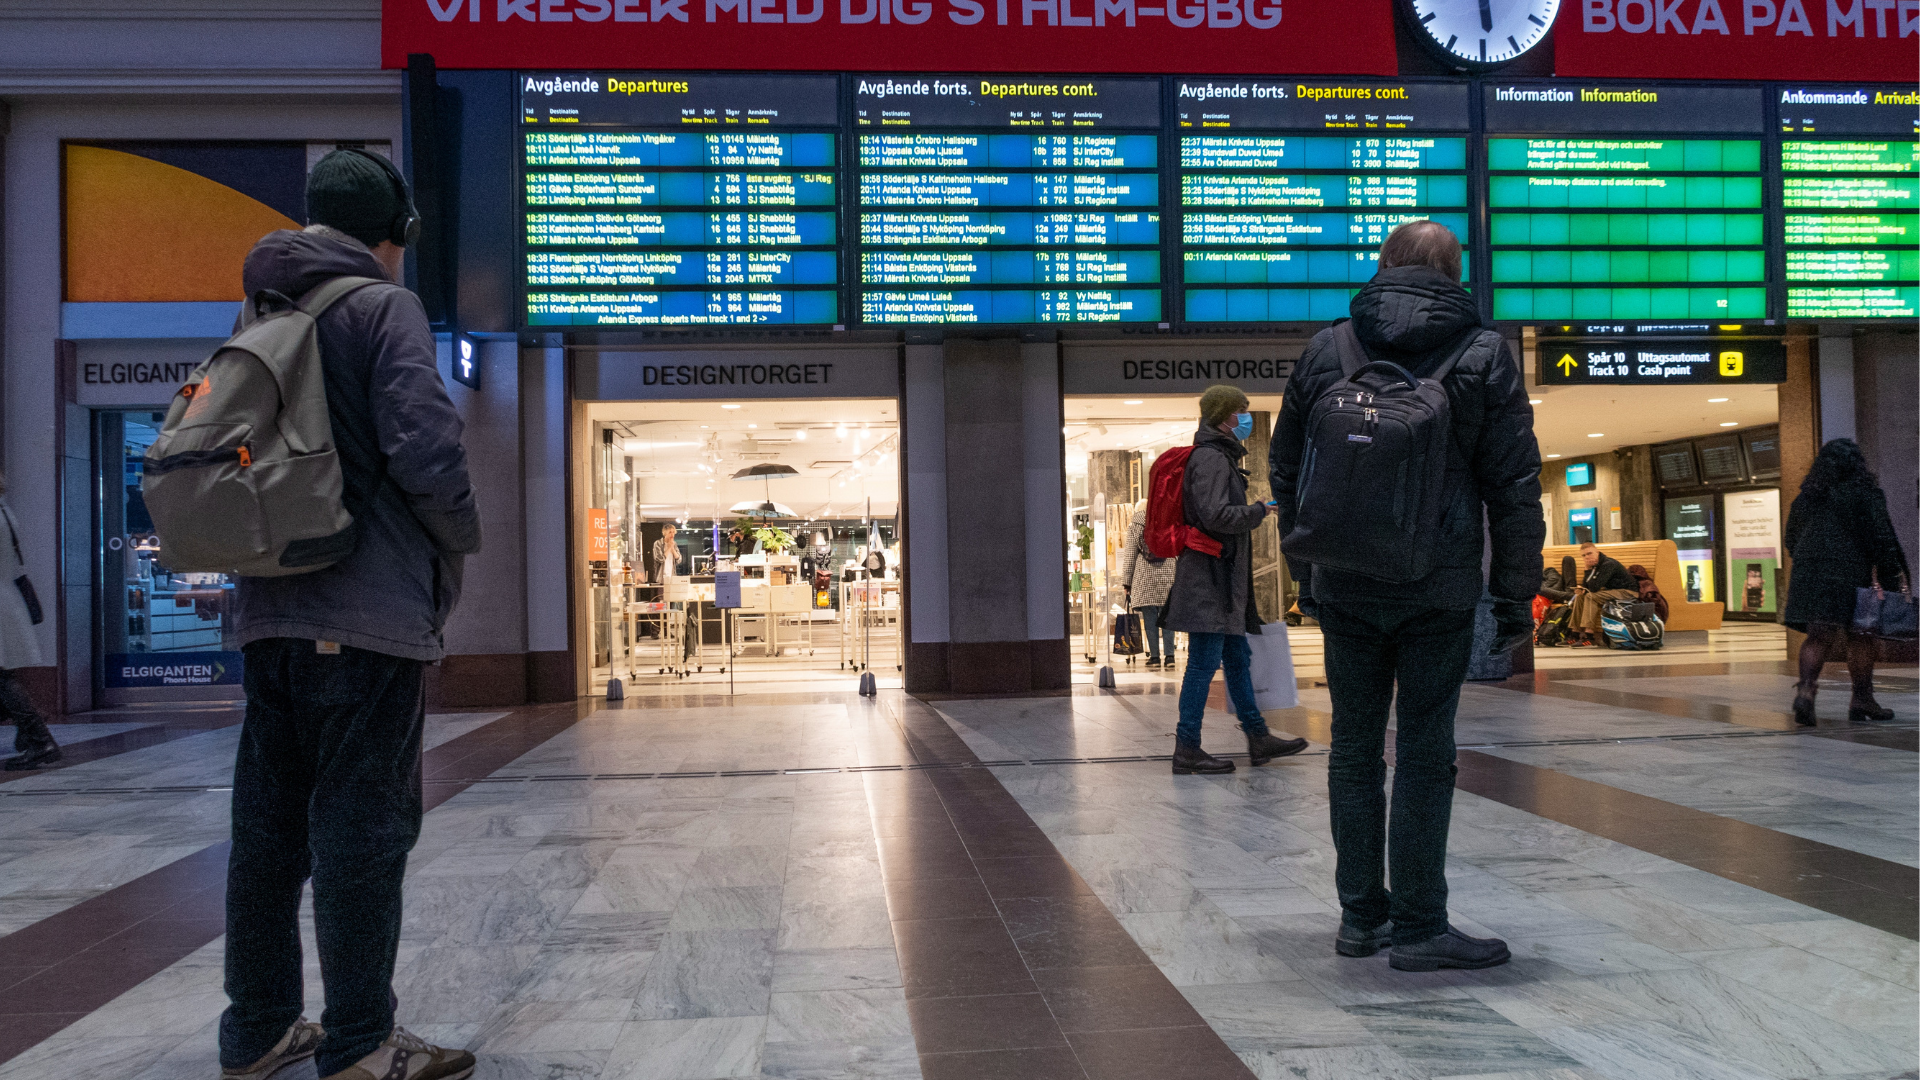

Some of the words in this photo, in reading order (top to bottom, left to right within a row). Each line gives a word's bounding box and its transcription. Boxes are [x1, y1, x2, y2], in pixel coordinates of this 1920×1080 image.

[1582, 0, 1730, 35] BOKA
[525, 77, 599, 96] Avgående
[608, 78, 689, 96] Departures
[858, 80, 930, 98] Avgående
[934, 80, 972, 95] forts.
[981, 81, 1059, 98] Departures
[1063, 83, 1098, 96] cont.
[1180, 83, 1248, 100] Avgående
[1252, 84, 1289, 98] forts.
[1297, 85, 1371, 101] Departures
[1375, 87, 1409, 99] cont.
[1496, 86, 1574, 102] Information
[1581, 88, 1658, 102] Information
[1781, 90, 1868, 104] Ankommande
[1874, 91, 1920, 105] Arrivals
[526, 134, 547, 143] 17:53
[549, 134, 587, 144] Södertälje
[589, 134, 595, 143] S
[596, 134, 641, 143] Katrineholm
[642, 134, 676, 145] Vingåker
[706, 135, 720, 143] 14b
[722, 135, 744, 143] 10145
[746, 134, 780, 145] Mälartåg
[860, 136, 880, 145] 19:14
[881, 135, 914, 145] Västerås
[916, 134, 941, 145] Örebro
[942, 136, 978, 146] Hallsberg
[1038, 136, 1047, 145] 16
[1053, 136, 1067, 145] 760
[1073, 136, 1083, 145] SJ
[1084, 136, 1116, 146] Regional
[1528, 140, 1546, 148] Tack
[1546, 140, 1556, 148] för
[526, 145, 546, 154] 18:11
[549, 145, 570, 154] Luleå
[571, 145, 594, 154] Umeå
[595, 145, 620, 154] Narvik
[710, 146, 720, 154] 12
[728, 146, 738, 154] 94
[746, 146, 757, 155] Vy
[758, 145, 783, 155] Nattåg
[1568, 151, 1578, 159] du
[1181, 159, 1201, 167] 22:55
[1202, 158, 1214, 167] Åre
[1216, 158, 1253, 167] Östersund
[1254, 159, 1278, 167] Duved
[1352, 160, 1361, 168] 12
[1364, 160, 1382, 168] 3900
[1527, 161, 1552, 169] Använd
[1554, 178, 1570, 186] keep
[1572, 178, 1600, 186] distance
[1601, 178, 1614, 186] and
[1635, 179, 1667, 187] crowding.
[527, 225, 548, 234] 18:32
[549, 225, 594, 234] Katrineholm
[596, 225, 632, 235] Hallsberg
[633, 225, 665, 234] Karlstad
[748, 225, 759, 233] SJ
[760, 225, 796, 235] Snabbtåg
[1184, 253, 1204, 261] 00:11
[1205, 253, 1233, 261] Arlanda
[1234, 253, 1260, 261] Knivsta
[1261, 253, 1291, 262] Uppsala
[1355, 253, 1364, 261] 16
[528, 276, 549, 284] 18:48
[550, 275, 579, 284] Skövde
[580, 275, 617, 285] Falköping
[619, 275, 654, 285] Göteborg
[725, 275, 744, 283] 2045
[748, 275, 773, 283] MTRX
[862, 304, 883, 312] 22:11
[885, 304, 913, 312] Arlanda
[915, 303, 942, 312] Knivsta
[943, 303, 974, 313] Uppsala
[1077, 302, 1108, 312] Mälartåg
[1716, 300, 1728, 308] 1/2
[598, 315, 627, 324] Arlanda
[629, 315, 659, 325] Express
[661, 315, 689, 325] departs
[690, 315, 708, 323] from
[709, 315, 728, 323] track
[730, 315, 734, 323] 1
[736, 315, 750, 323] and
[753, 315, 758, 323] 2
[1587, 352, 1611, 364] Spår
[1614, 353, 1626, 363] 10
[1638, 352, 1710, 365] Uttagsautomat
[642, 364, 833, 386] DESIGNTORGET
[1588, 365, 1615, 376] Track
[1617, 365, 1629, 376] 10
[1638, 365, 1663, 376] Cash
[1664, 365, 1691, 378] point
[122, 665, 212, 677] ELGIGANTEN
